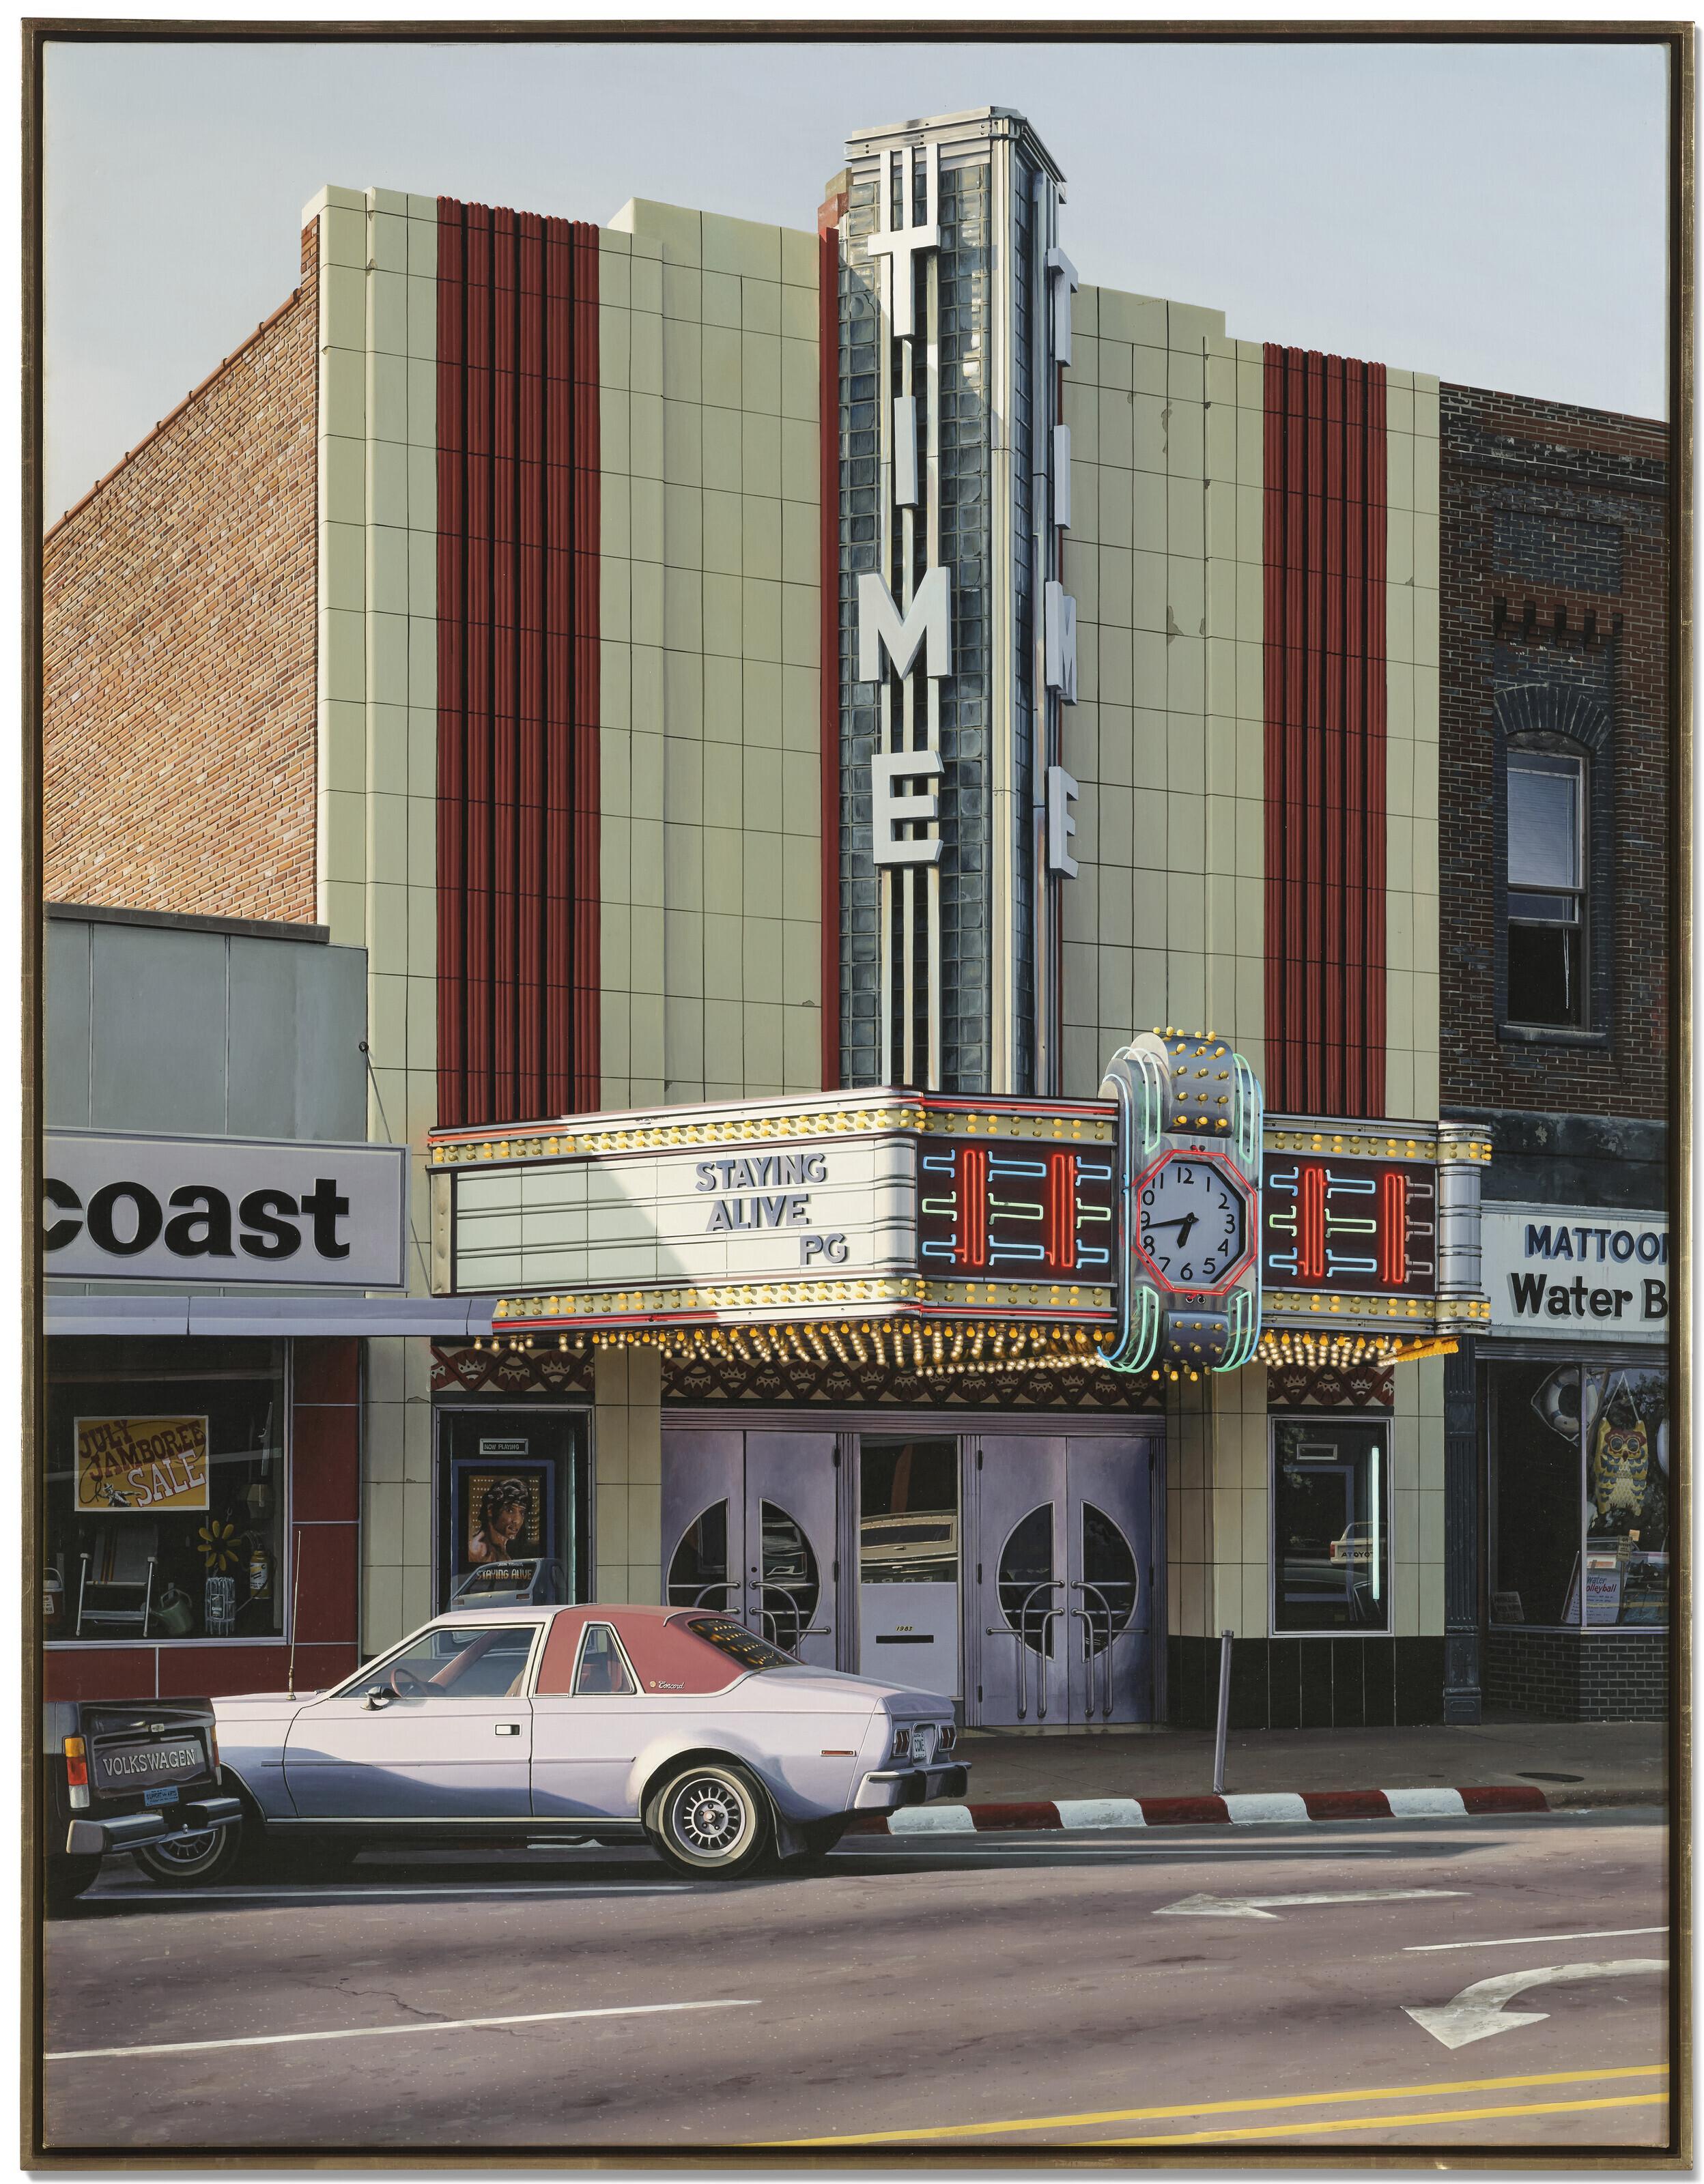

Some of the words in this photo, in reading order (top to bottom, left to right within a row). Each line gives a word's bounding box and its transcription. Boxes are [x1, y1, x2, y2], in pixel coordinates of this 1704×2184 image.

[857, 223, 952, 866] TIME
[1045, 247, 1079, 880] TIME
[695, 1153, 826, 1191] STAYING
[1152, 1173, 1163, 1189] 11
[1178, 1167, 1195, 1184] 12
[1206, 1177, 1210, 1192] 1
[1218, 1192, 1230, 1209] 2
[43, 1178, 350, 1261] coast
[705, 1194, 809, 1232] ALIVE
[1141, 1211, 1151, 1231] 9
[1224, 1214, 1236, 1234] 3
[799, 1233, 847, 1265] PG
[1143, 1235, 1155, 1256] 8
[1217, 1239, 1228, 1256] 4
[1159, 1256, 1171, 1273] 7
[1180, 1263, 1193, 1280] 6
[1202, 1258, 1216, 1274] 5
[1507, 1273, 1633, 1321] Water
[79, 1420, 134, 1459] JULY
[89, 1420, 205, 1482] JAMBOREE
[128, 1449, 207, 1508] SALE
[477, 1569, 509, 1580] STAYING
[511, 1569, 532, 1580] ALIVE
[1587, 1576, 1607, 1584] water
[1586, 1584, 1617, 1594] olleyball
[658, 1680, 685, 1689] Concord
[103, 1749, 196, 1776] VOLKSWAGEN
